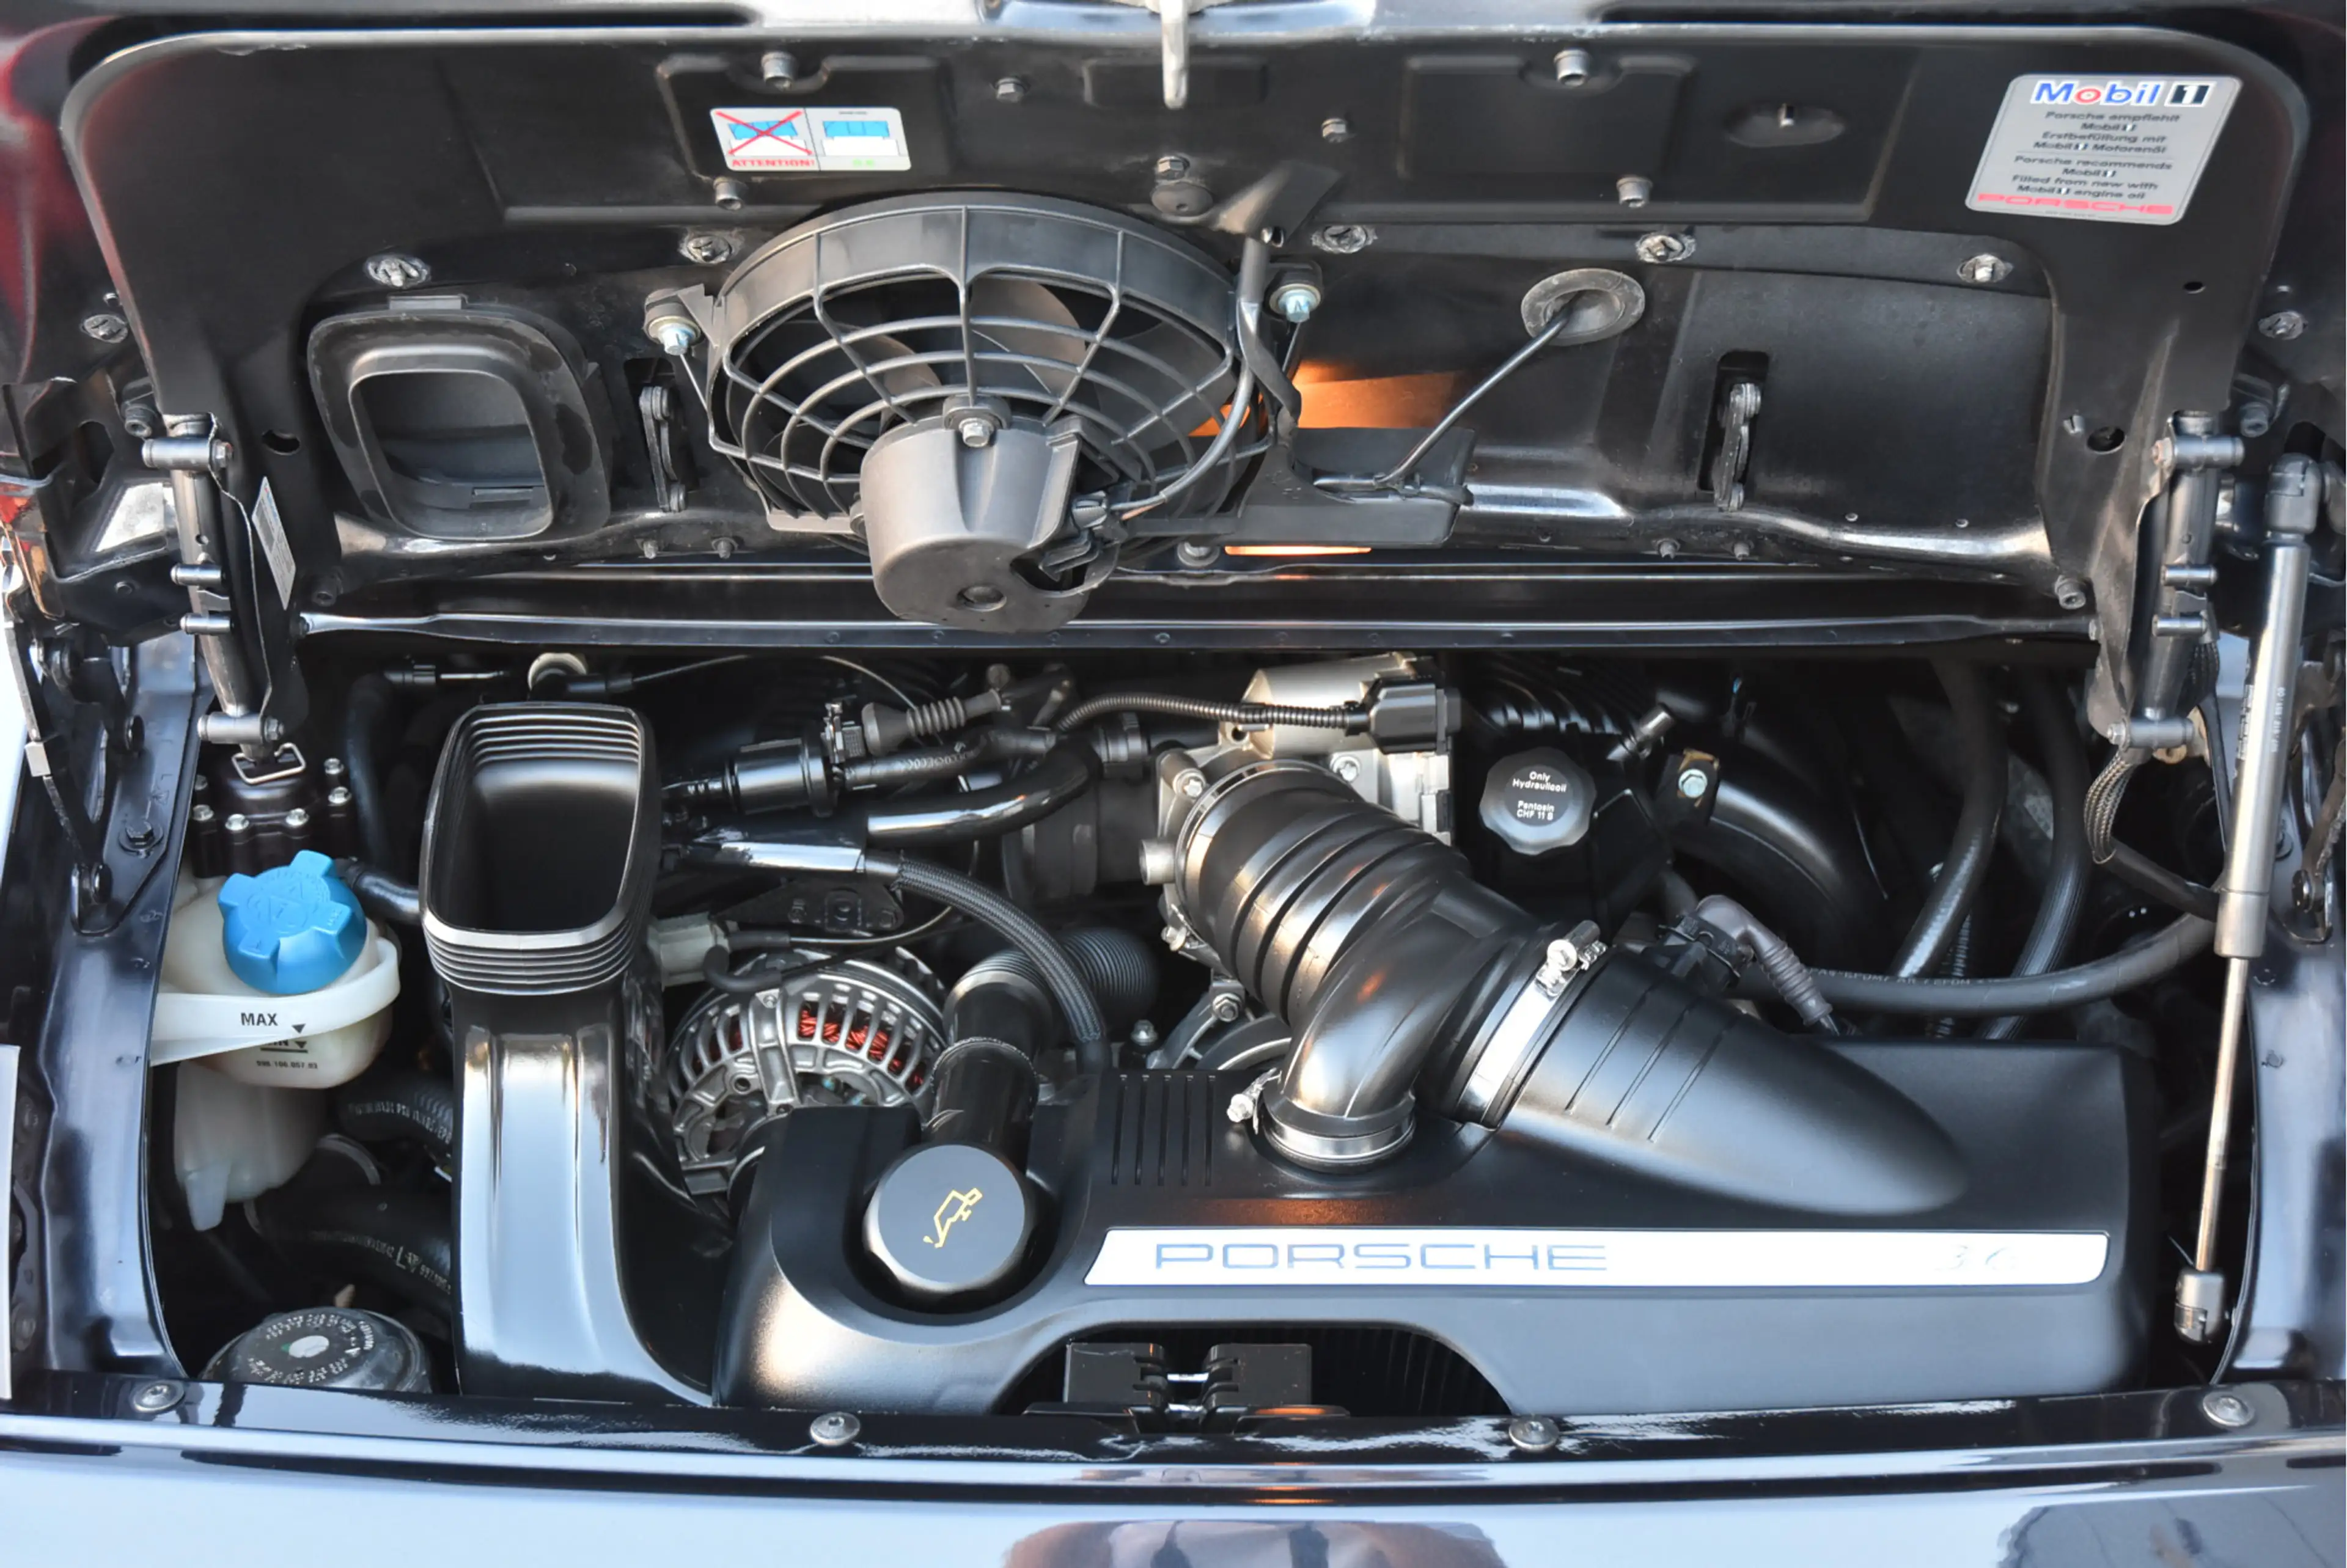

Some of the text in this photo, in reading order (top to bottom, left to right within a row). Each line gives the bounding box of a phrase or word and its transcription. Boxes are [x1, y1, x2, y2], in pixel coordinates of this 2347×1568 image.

[2033, 82, 2162, 104] Mobil
[2044, 111, 2105, 120] Porsche
[2081, 122, 2120, 131] Mobil
[2042, 131, 2167, 144] Erstbefüllung mit
[2033, 141, 2073, 150] Mobil
[2092, 144, 2167, 154] Motorenöl
[2014, 155, 2173, 170] Porsche recommends
[2062, 168, 2101, 177] Mobil
[2011, 175, 2050, 183] Filled
[2054, 177, 2087, 186] from
[2128, 182, 2159, 191] with
[2017, 185, 2055, 194] Mobil
[2074, 189, 2123, 200] engine
[1977, 193, 2174, 215] PORSCHE
[1529, 771, 1551, 783] Only
[1517, 808, 1535, 818] CHF
[1538, 811, 1545, 819] 11
[240, 1012, 279, 1027] MAX
[1155, 1243, 1608, 1271] PORSCHE
